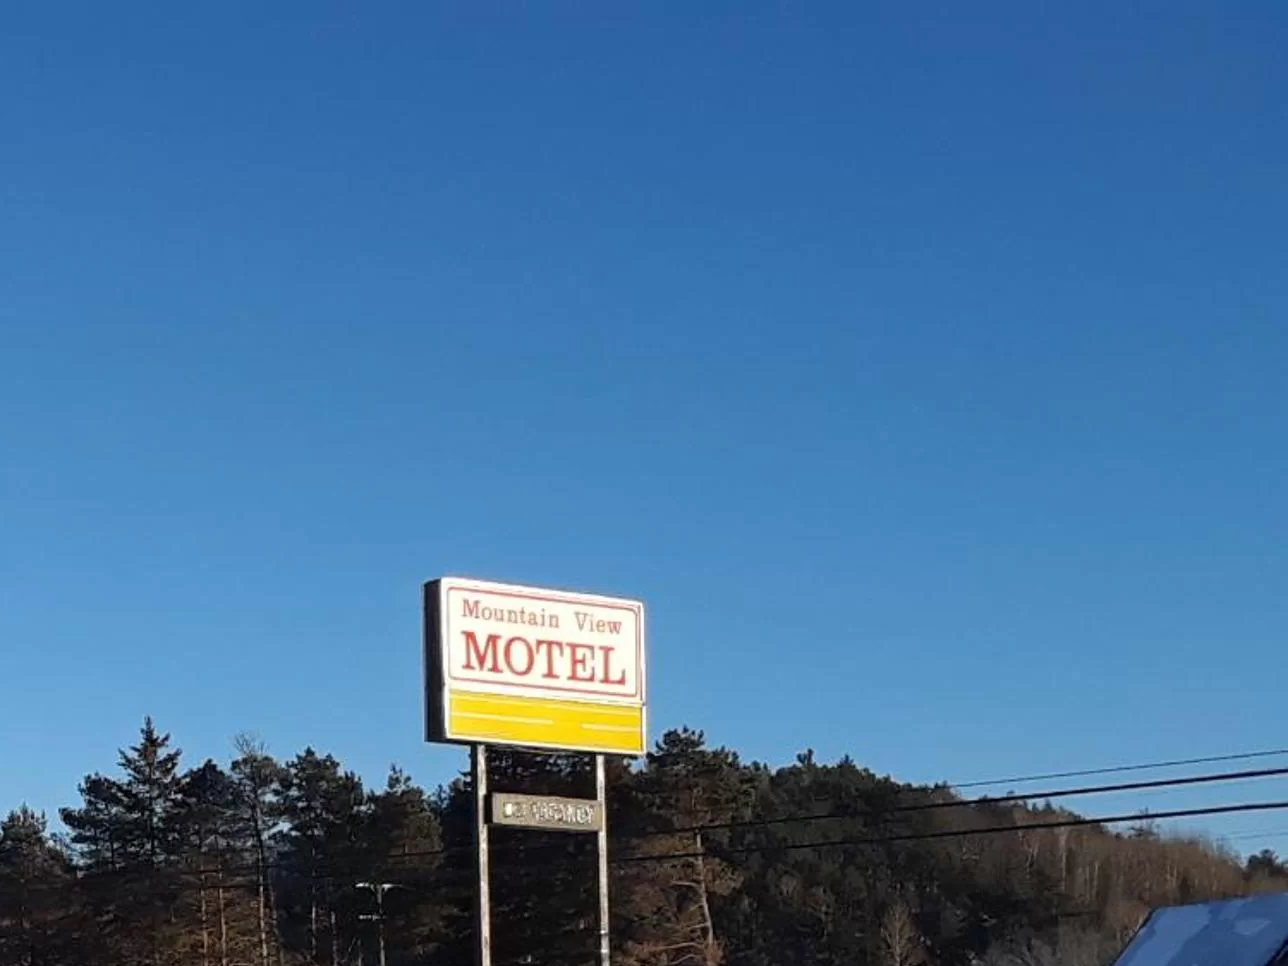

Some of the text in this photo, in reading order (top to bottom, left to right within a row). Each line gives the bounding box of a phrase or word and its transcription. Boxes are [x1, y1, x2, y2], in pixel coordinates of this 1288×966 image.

[462, 599, 623, 635] Mountain View
[461, 630, 626, 686] MOTEL
